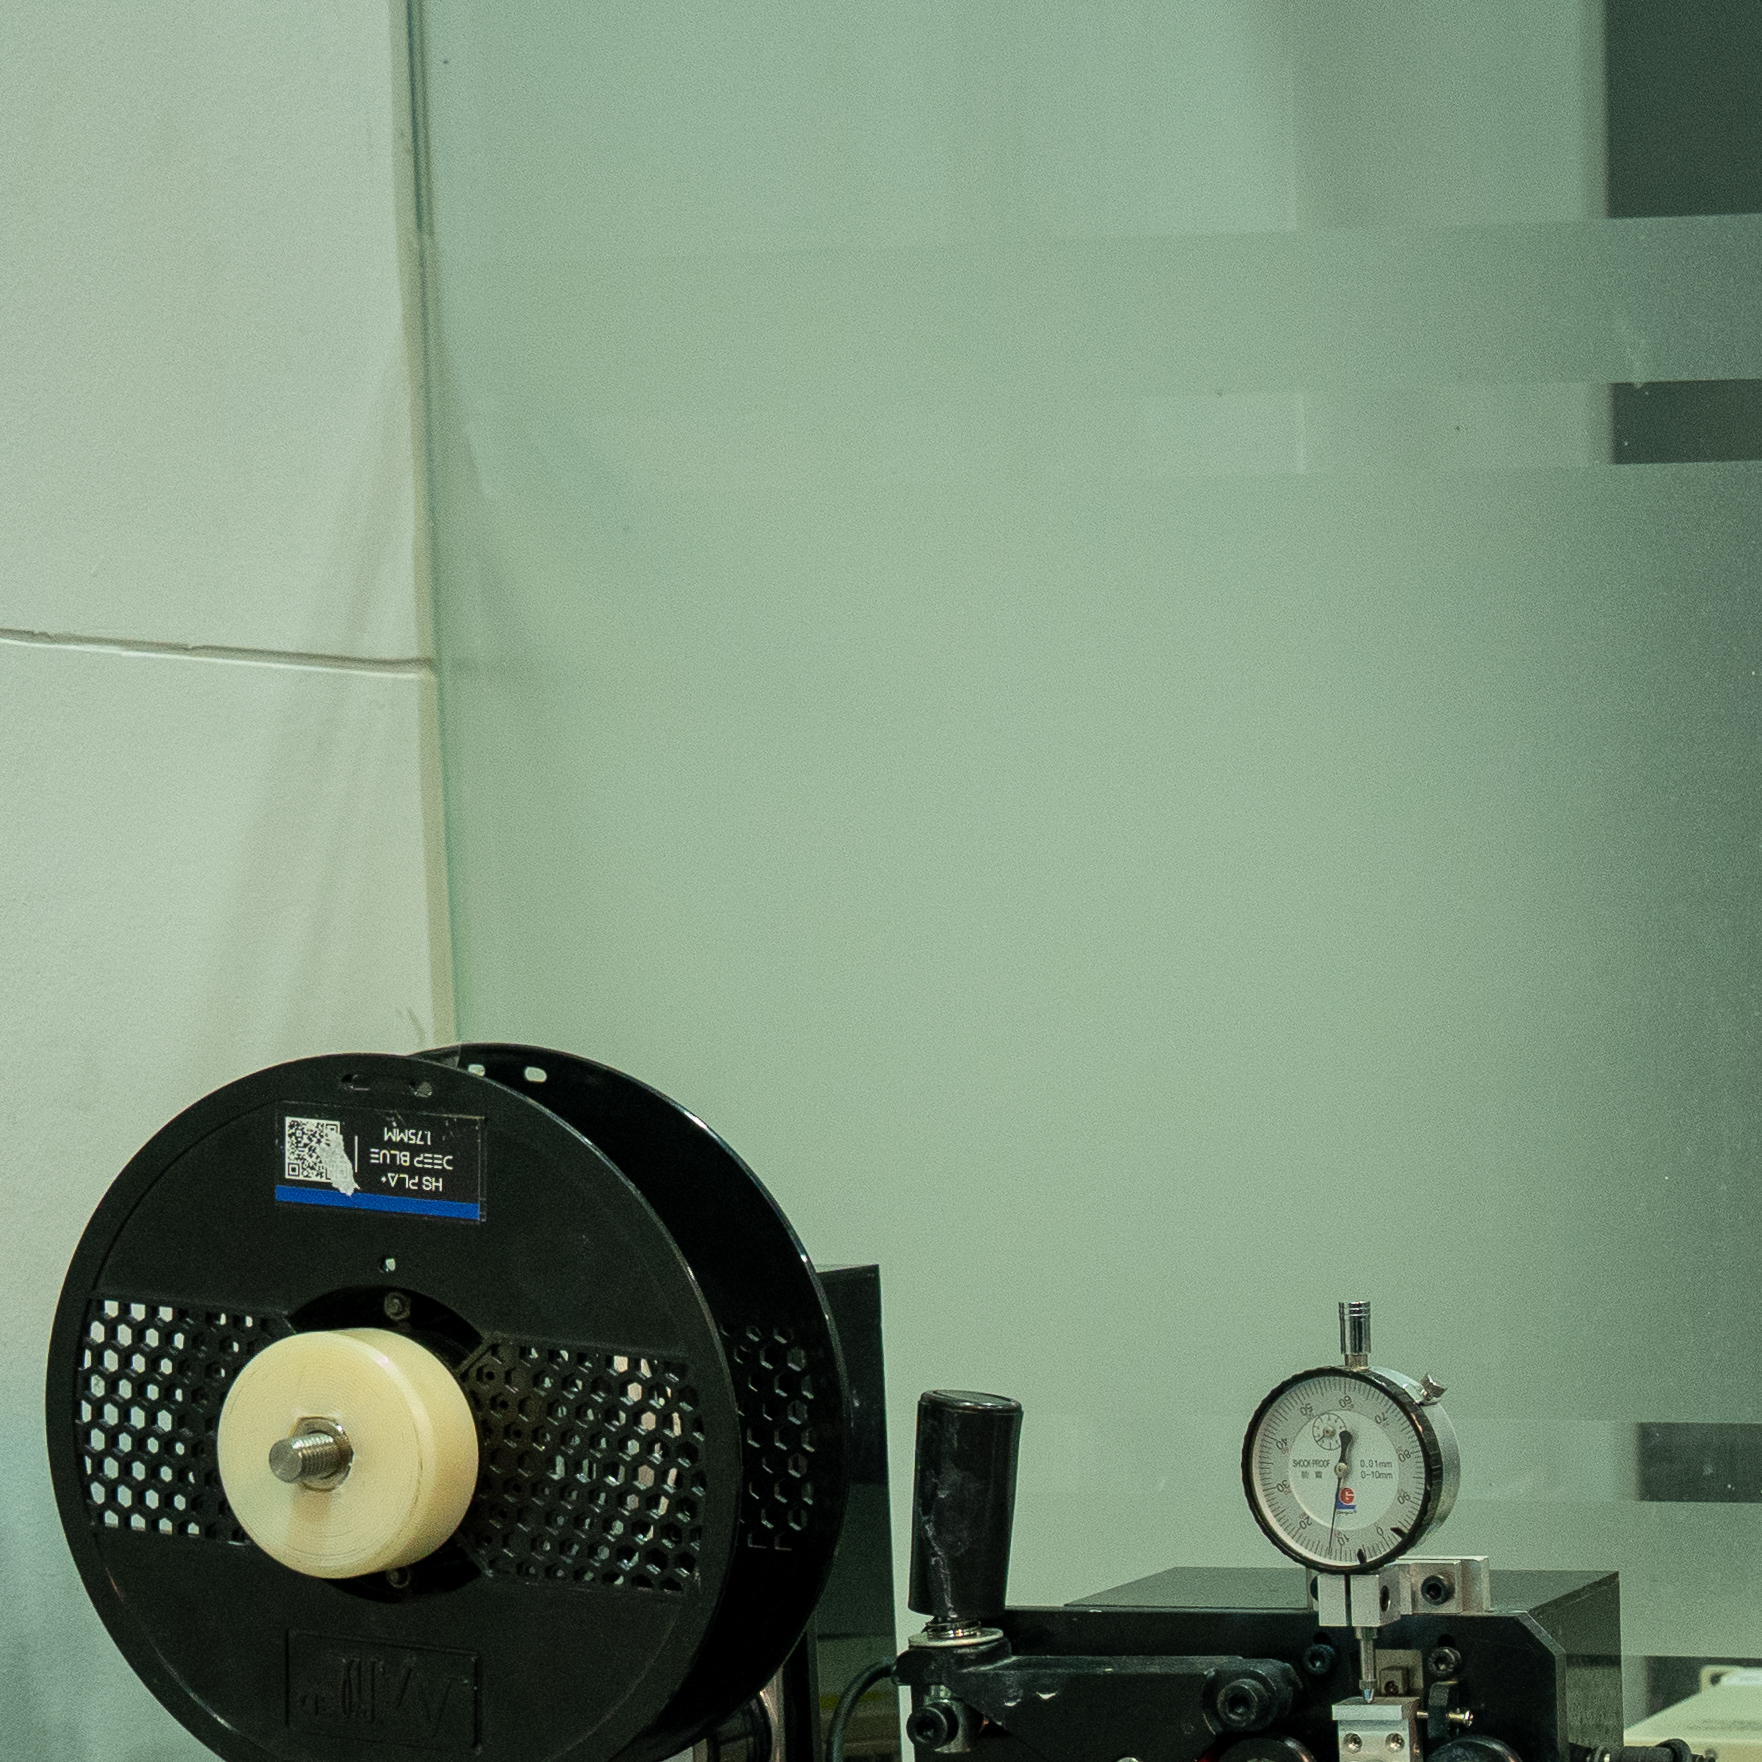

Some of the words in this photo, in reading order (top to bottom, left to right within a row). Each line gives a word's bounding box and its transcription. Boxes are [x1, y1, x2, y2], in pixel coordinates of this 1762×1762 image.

[383, 1127, 432, 1145] 1.75MM
[370, 1148, 410, 1166] BLUE
[413, 1153, 454, 1170] DEEP
[422, 1176, 443, 1192] HS
[1339, 1395, 1352, 1408] 60
[1300, 1403, 1313, 1416] 50
[1374, 1412, 1388, 1424] 70
[1360, 1459, 1393, 1468] 0.01mm
[1299, 1515, 1313, 1530] 20
